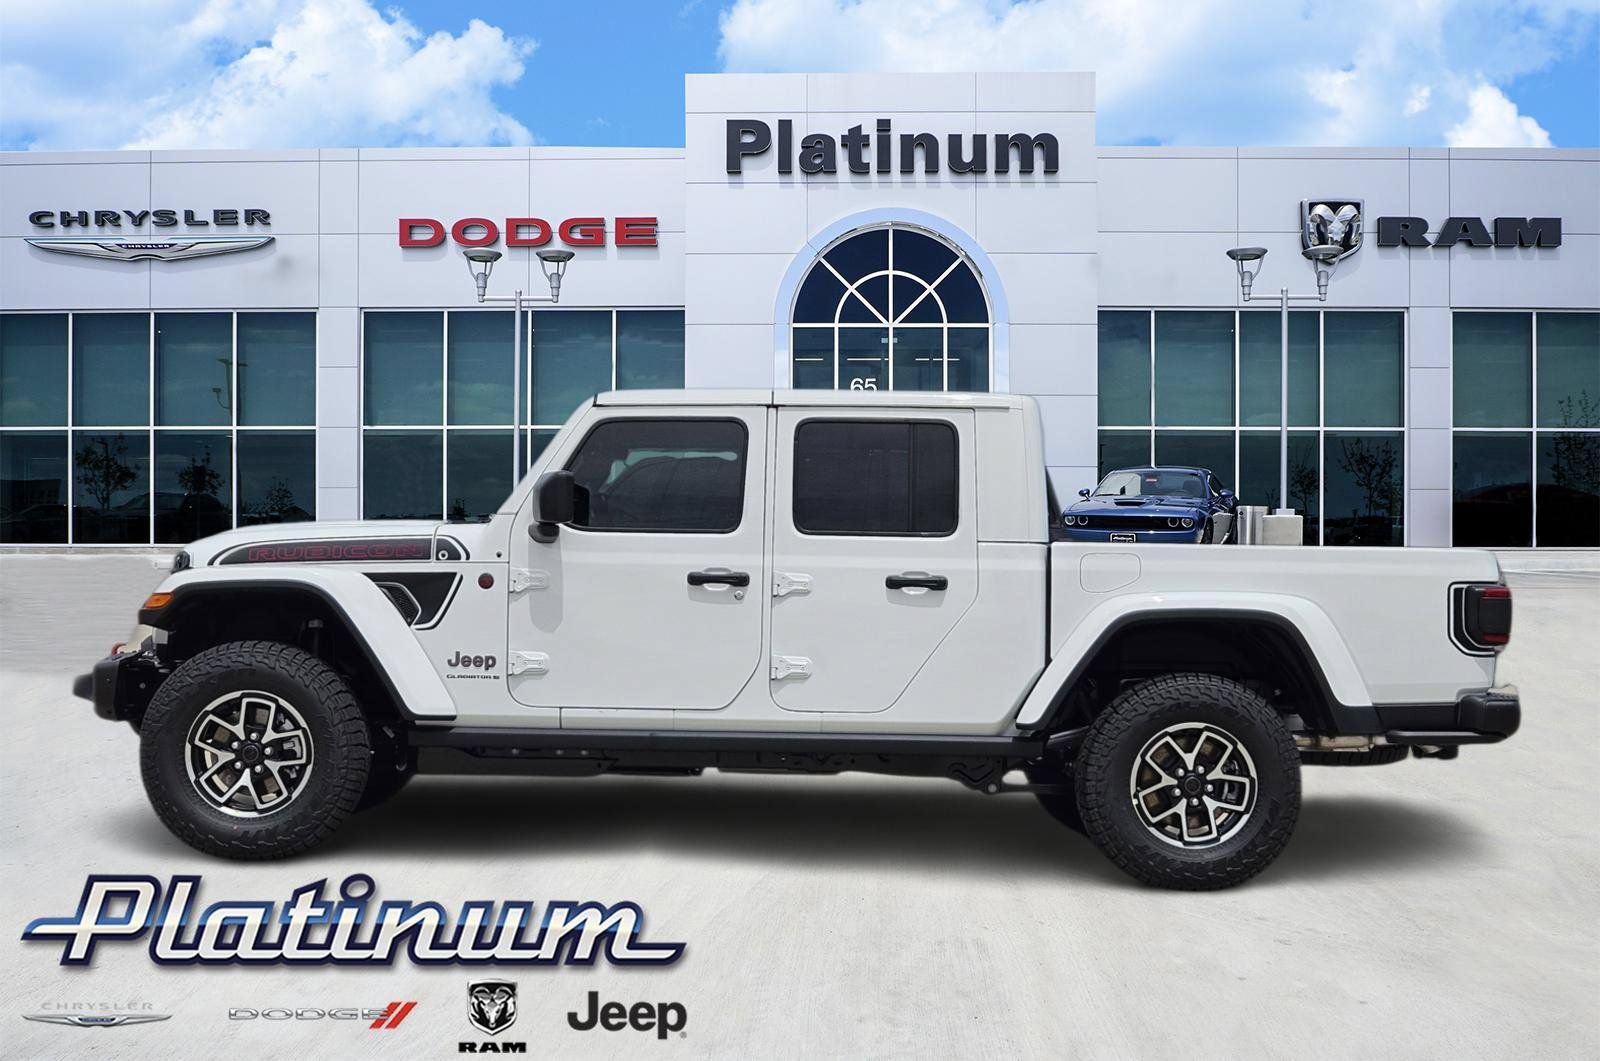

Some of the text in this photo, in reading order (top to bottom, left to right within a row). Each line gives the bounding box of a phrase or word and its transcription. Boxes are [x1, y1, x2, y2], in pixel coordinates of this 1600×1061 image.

[726, 119, 1059, 175] Platinum
[28, 209, 272, 228] CHRYSLER
[399, 217, 658, 248] DODGE
[1377, 216, 1562, 248] RAM
[248, 542, 426, 562] RUBICON
[447, 650, 497, 671] Jeep
